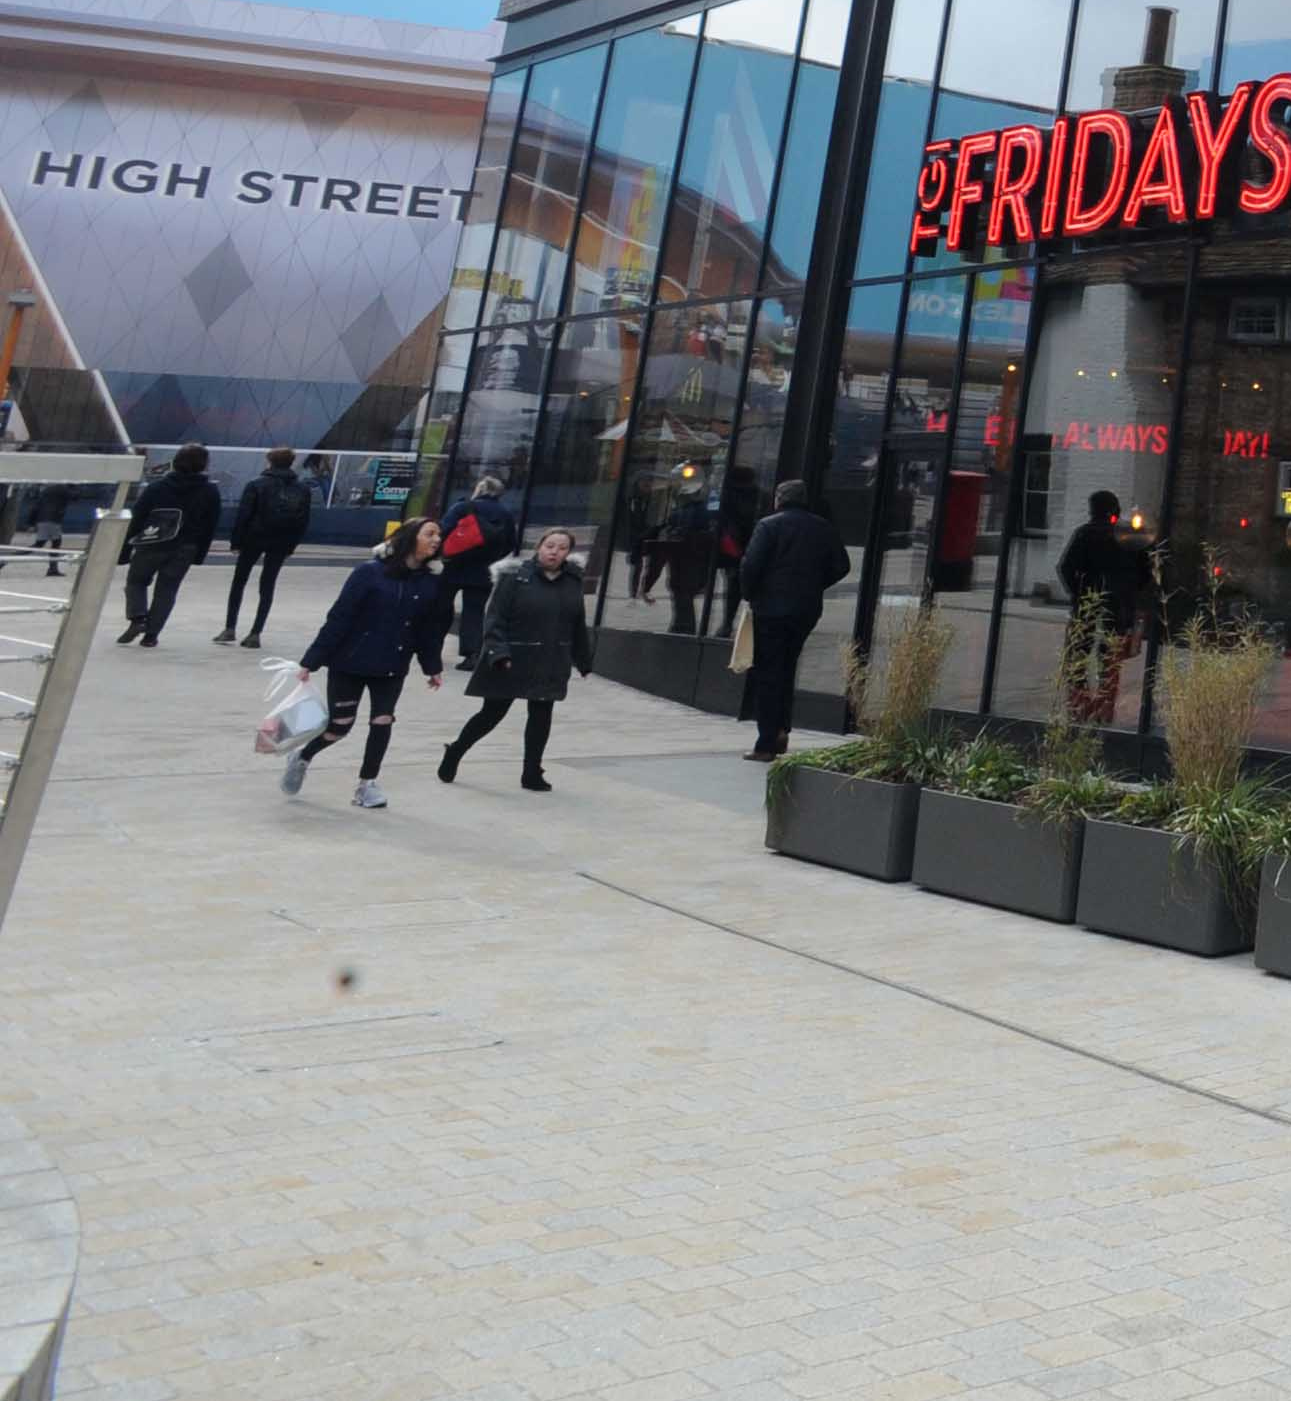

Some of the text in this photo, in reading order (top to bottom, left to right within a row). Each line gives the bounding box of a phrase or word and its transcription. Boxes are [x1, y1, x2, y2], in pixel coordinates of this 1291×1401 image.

[32, 150, 479, 223] HIGH STREET
[1062, 422, 1169, 455] ALWAYS
